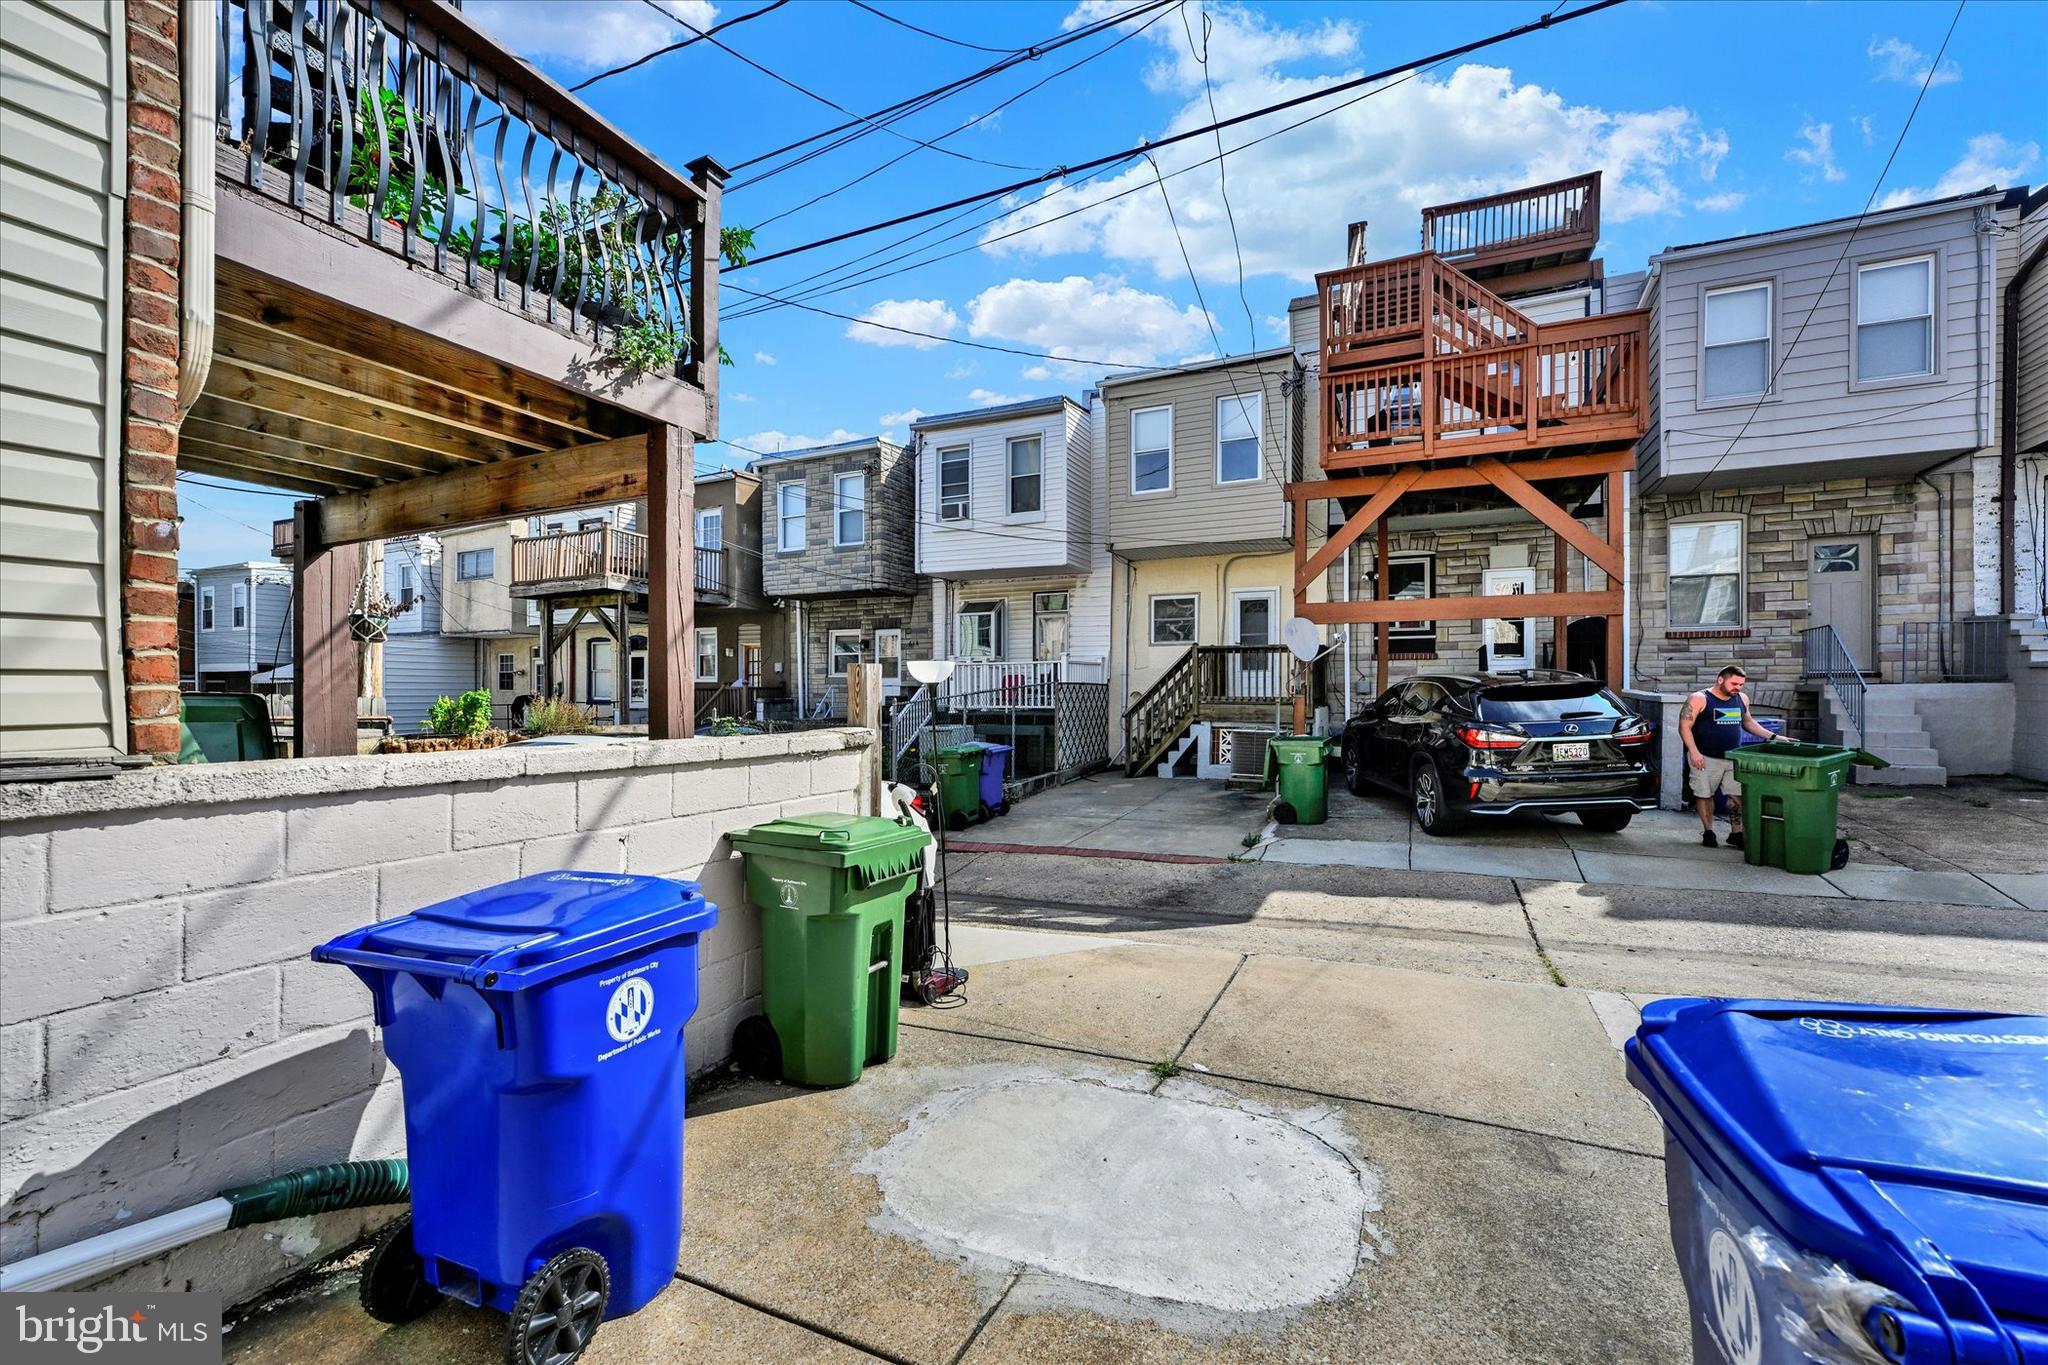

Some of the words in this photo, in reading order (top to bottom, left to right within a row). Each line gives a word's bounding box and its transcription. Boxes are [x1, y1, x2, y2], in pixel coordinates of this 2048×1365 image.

[600, 975, 621, 988] Property
[627, 965, 650, 978] Baltimore
[649, 961, 659, 969] City
[597, 1044, 628, 1062] Department
[627, 1041, 633, 1049] of
[633, 1035, 647, 1046] Public
[646, 1028, 661, 1038] Works
[1859, 1027, 1917, 1040] ONLY
